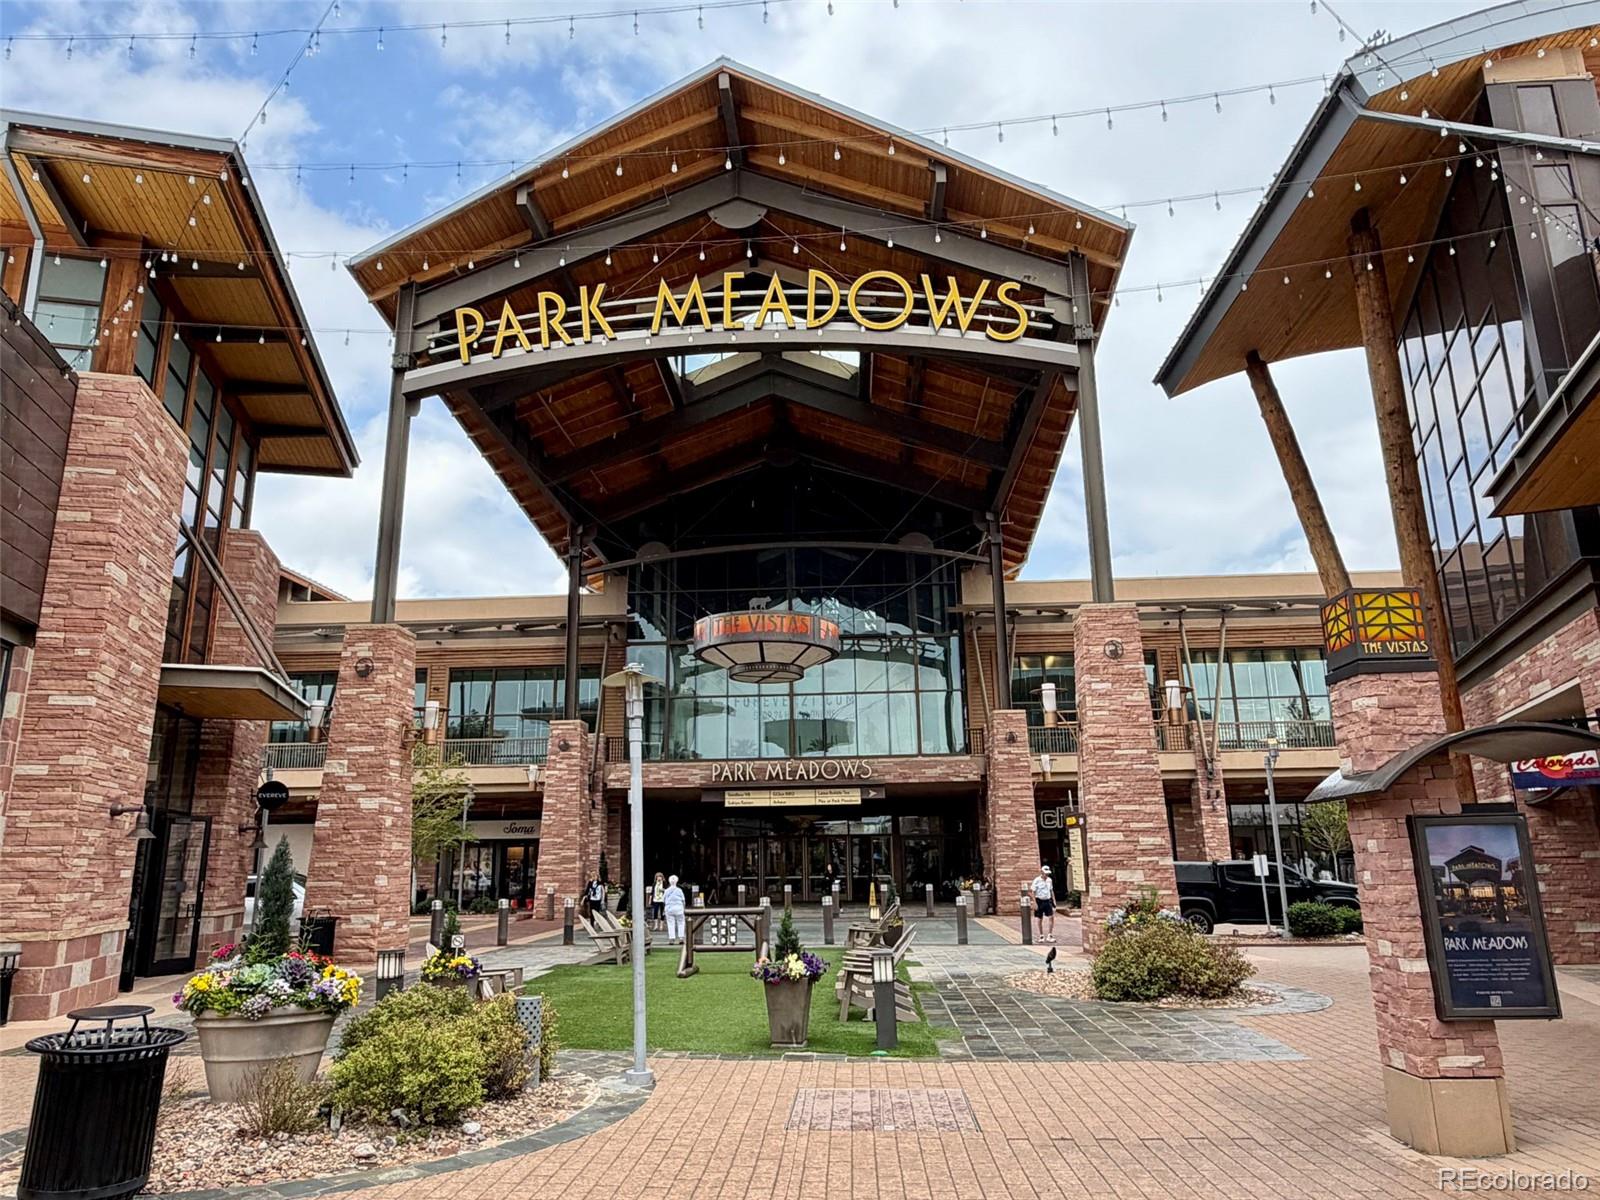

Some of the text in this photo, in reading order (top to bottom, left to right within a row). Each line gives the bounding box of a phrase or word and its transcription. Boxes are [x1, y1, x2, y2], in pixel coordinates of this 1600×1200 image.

[455, 269, 1029, 365] PARK MEADOWS
[715, 615, 809, 634] THE VISTAS
[1361, 640, 1429, 653] THE VISTAS
[711, 759, 873, 782] PARK MEADOWS
[1516, 753, 1597, 772] Colorado
[503, 822, 536, 834] Soma
[1444, 936, 1529, 951] PARK MEADOWS
